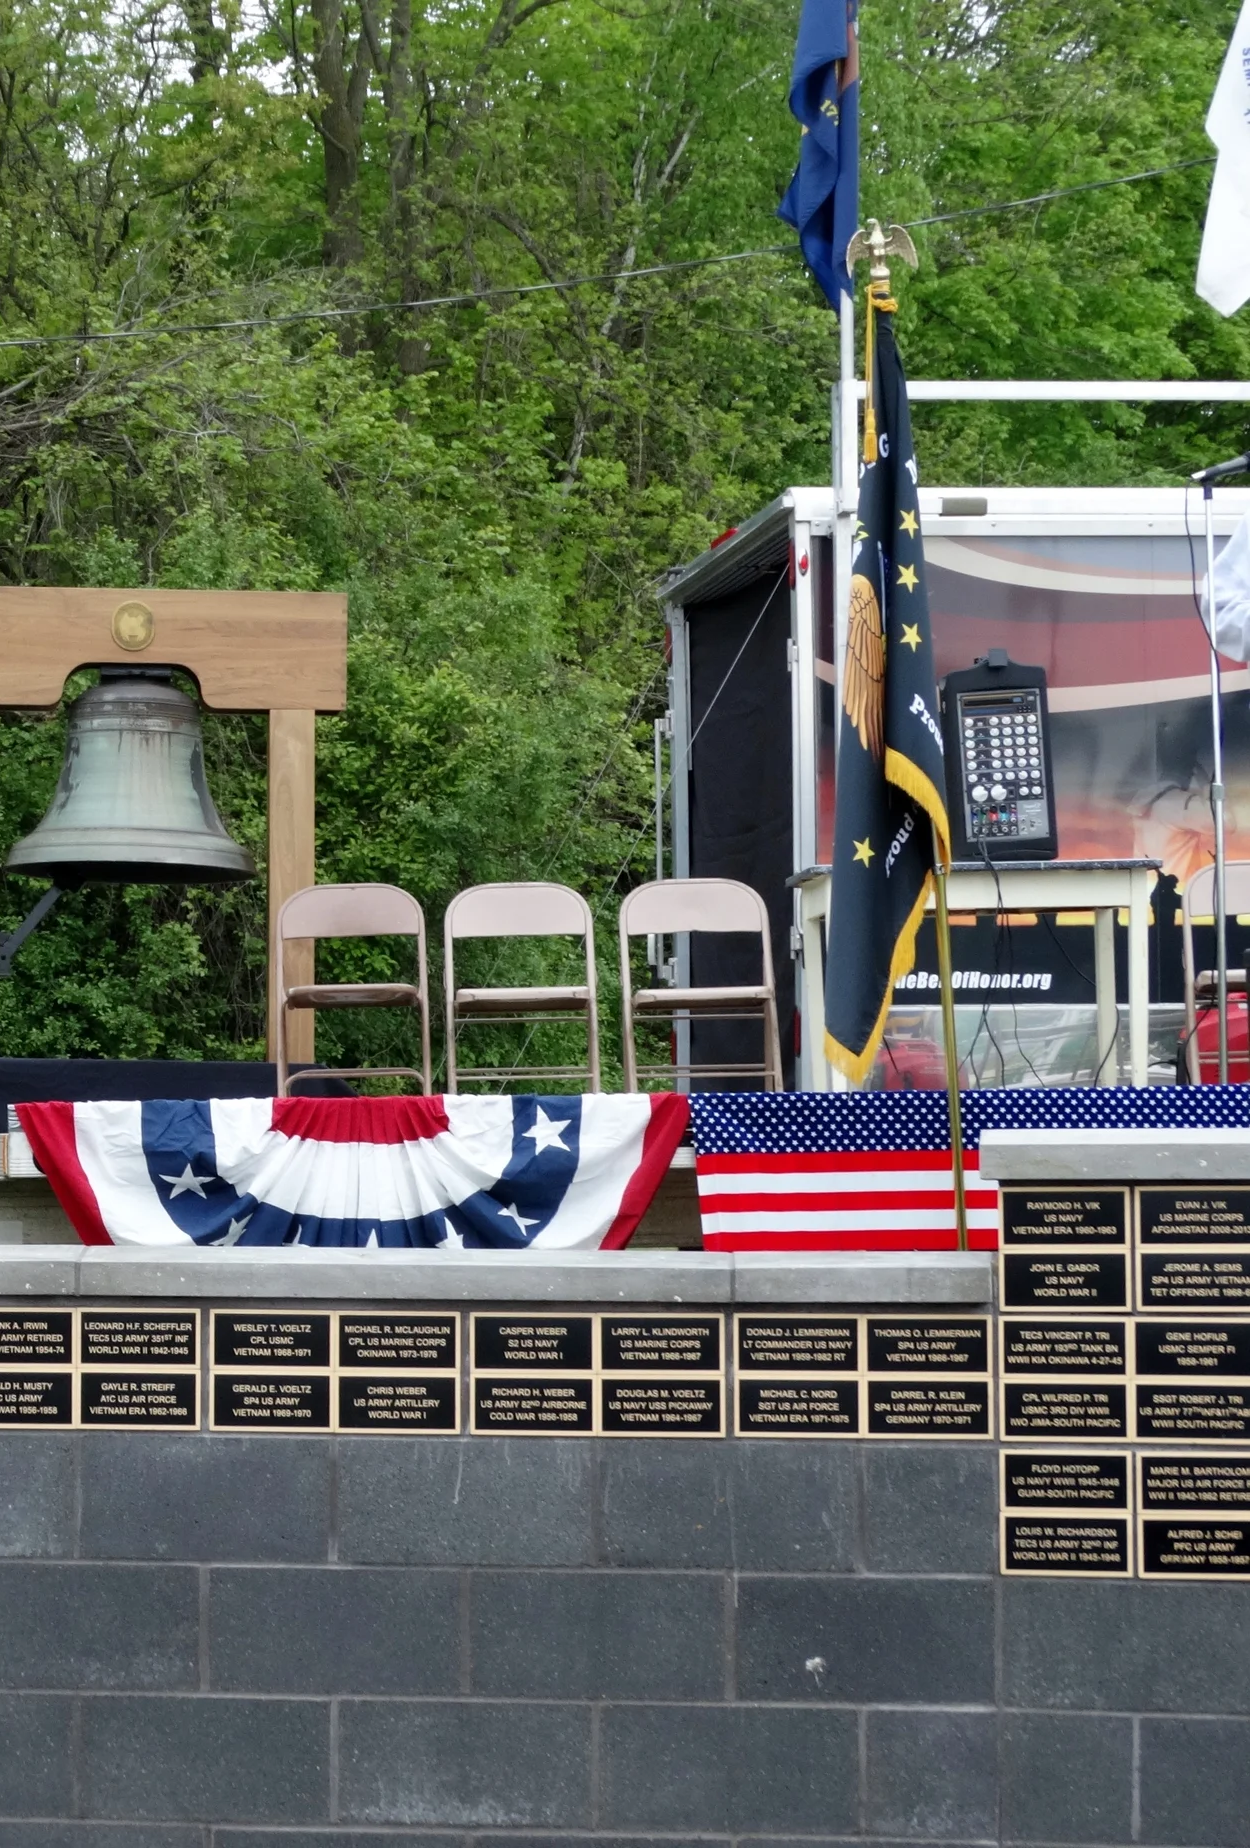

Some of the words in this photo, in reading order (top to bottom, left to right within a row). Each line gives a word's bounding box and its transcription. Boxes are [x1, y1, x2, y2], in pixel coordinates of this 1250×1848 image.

[885, 812, 915, 879] roud
[23, 1322, 48, 1330] IRWIN
[84, 1322, 125, 1331] LEONARD
[143, 1323, 192, 1331] SCHEFFLER
[233, 1324, 269, 1332] WESLEY
[279, 1324, 311, 1333] VOELTZ
[345, 1325, 382, 1334] MICHAEL
[395, 1326, 450, 1334] MCLAUGHLIN
[499, 1327, 534, 1335] CASPER
[535, 1327, 567, 1336] WEBER
[611, 1327, 641, 1336] LARRY
[652, 1328, 709, 1336] KLINDWORTH
[746, 1328, 783, 1337] DONALD
[793, 1328, 850, 1337] LEMMERMAN
[874, 1329, 912, 1338] THOMAS
[924, 1329, 981, 1338] LEMMERMAN
[27, 1334, 63, 1342] RETIRED
[250, 1336, 267, 1344] CPL
[269, 1336, 294, 1345] USMC
[348, 1337, 365, 1346] CPL
[367, 1337, 379, 1346] US
[381, 1338, 414, 1346] MARINE
[416, 1338, 446, 1347] CORPS
[520, 1339, 533, 1348] US
[535, 1339, 558, 1347] NAVY
[620, 1340, 633, 1348] US
[634, 1340, 668, 1348] MARINE
[669, 1340, 701, 1349] CORPS
[88, 1346, 119, 1354] WORLD
[121, 1346, 141, 1354] WAR
[233, 1348, 271, 1356] VIETNAM
[357, 1349, 397, 1358] OKINAWA
[23, 1382, 53, 1390] MUSTY
[101, 1382, 128, 1391] GAYLE
[141, 1383, 176, 1391] STREIFF
[232, 1384, 268, 1393] GERALD
[279, 1385, 312, 1394] VOELTZ
[367, 1386, 394, 1395] CHRIS
[395, 1387, 427, 1395] WEBER
[492, 1388, 531, 1396] RICHARD
[543, 1388, 575, 1397] WEBER
[760, 1389, 799, 1398] MICHAEL
[811, 1390, 838, 1399] NORD
[891, 1391, 927, 1399] DARREL
[939, 1391, 965, 1400] KLEIN
[117, 1395, 130, 1403] US
[131, 1395, 146, 1403] AIR
[147, 1395, 177, 1404] FORCE
[354, 1398, 366, 1407] US
[367, 1398, 393, 1407] ARMY
[394, 1399, 440, 1407] ARTILLERY
